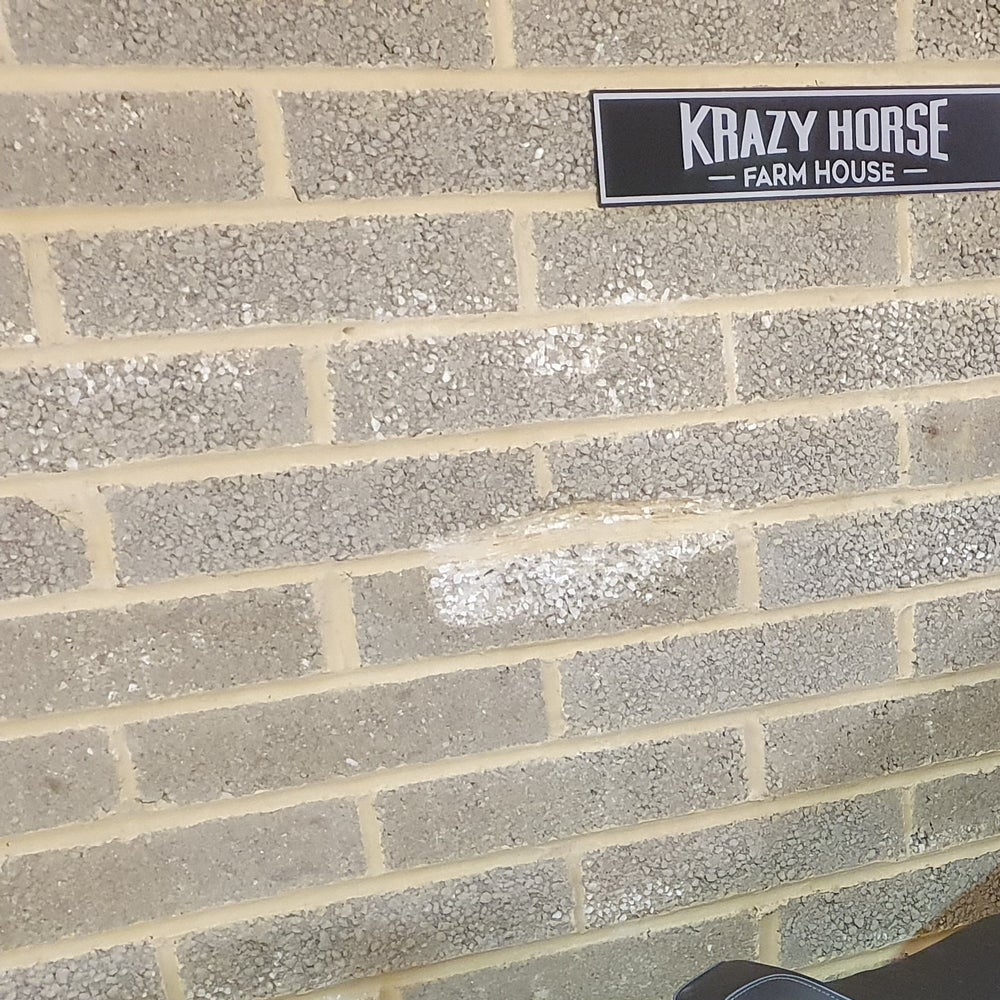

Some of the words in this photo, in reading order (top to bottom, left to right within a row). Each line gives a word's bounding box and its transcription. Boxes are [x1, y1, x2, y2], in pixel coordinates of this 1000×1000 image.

[679, 101, 818, 170] KRAZY
[829, 98, 949, 161] HORSE
[743, 162, 807, 187] FARM
[815, 159, 895, 183] HOUSE
